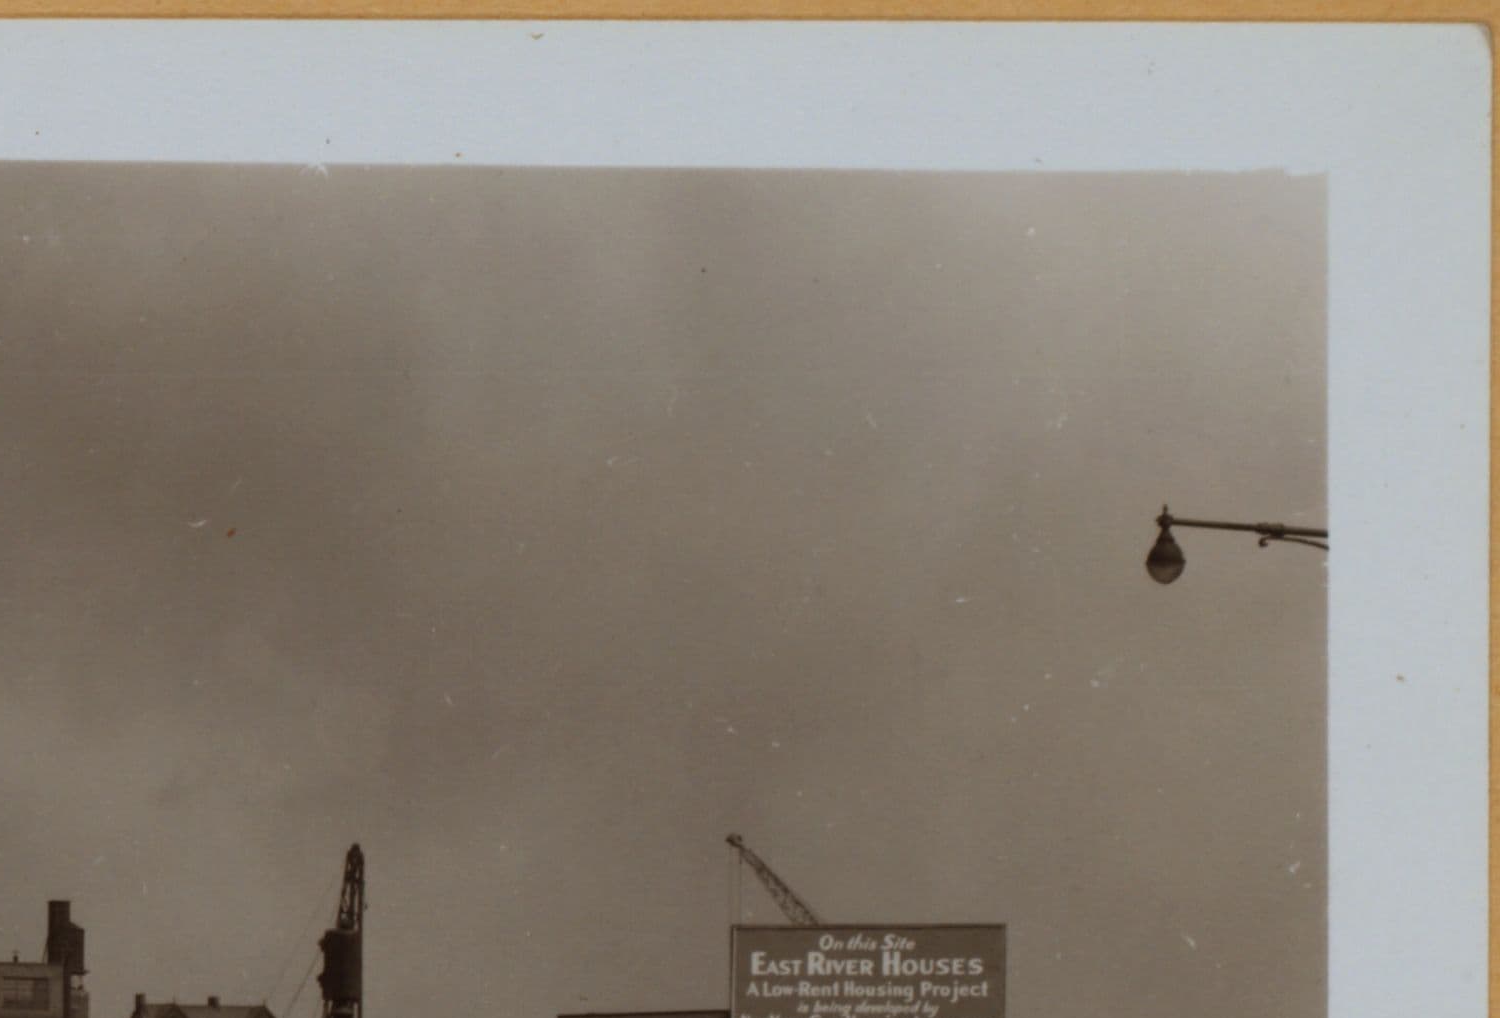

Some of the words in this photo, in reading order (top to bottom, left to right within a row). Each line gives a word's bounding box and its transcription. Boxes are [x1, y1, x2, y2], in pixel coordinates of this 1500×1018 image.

[819, 934, 844, 951] On
[847, 934, 878, 951] this
[880, 933, 916, 950] Site
[750, 951, 803, 976] EAST
[807, 951, 874, 976] RIVER
[882, 951, 984, 976] HOUSES
[746, 982, 760, 997] A
[763, 981, 841, 997] Low-Rent
[844, 981, 914, 1003] Housing
[920, 981, 989, 1003] Project
